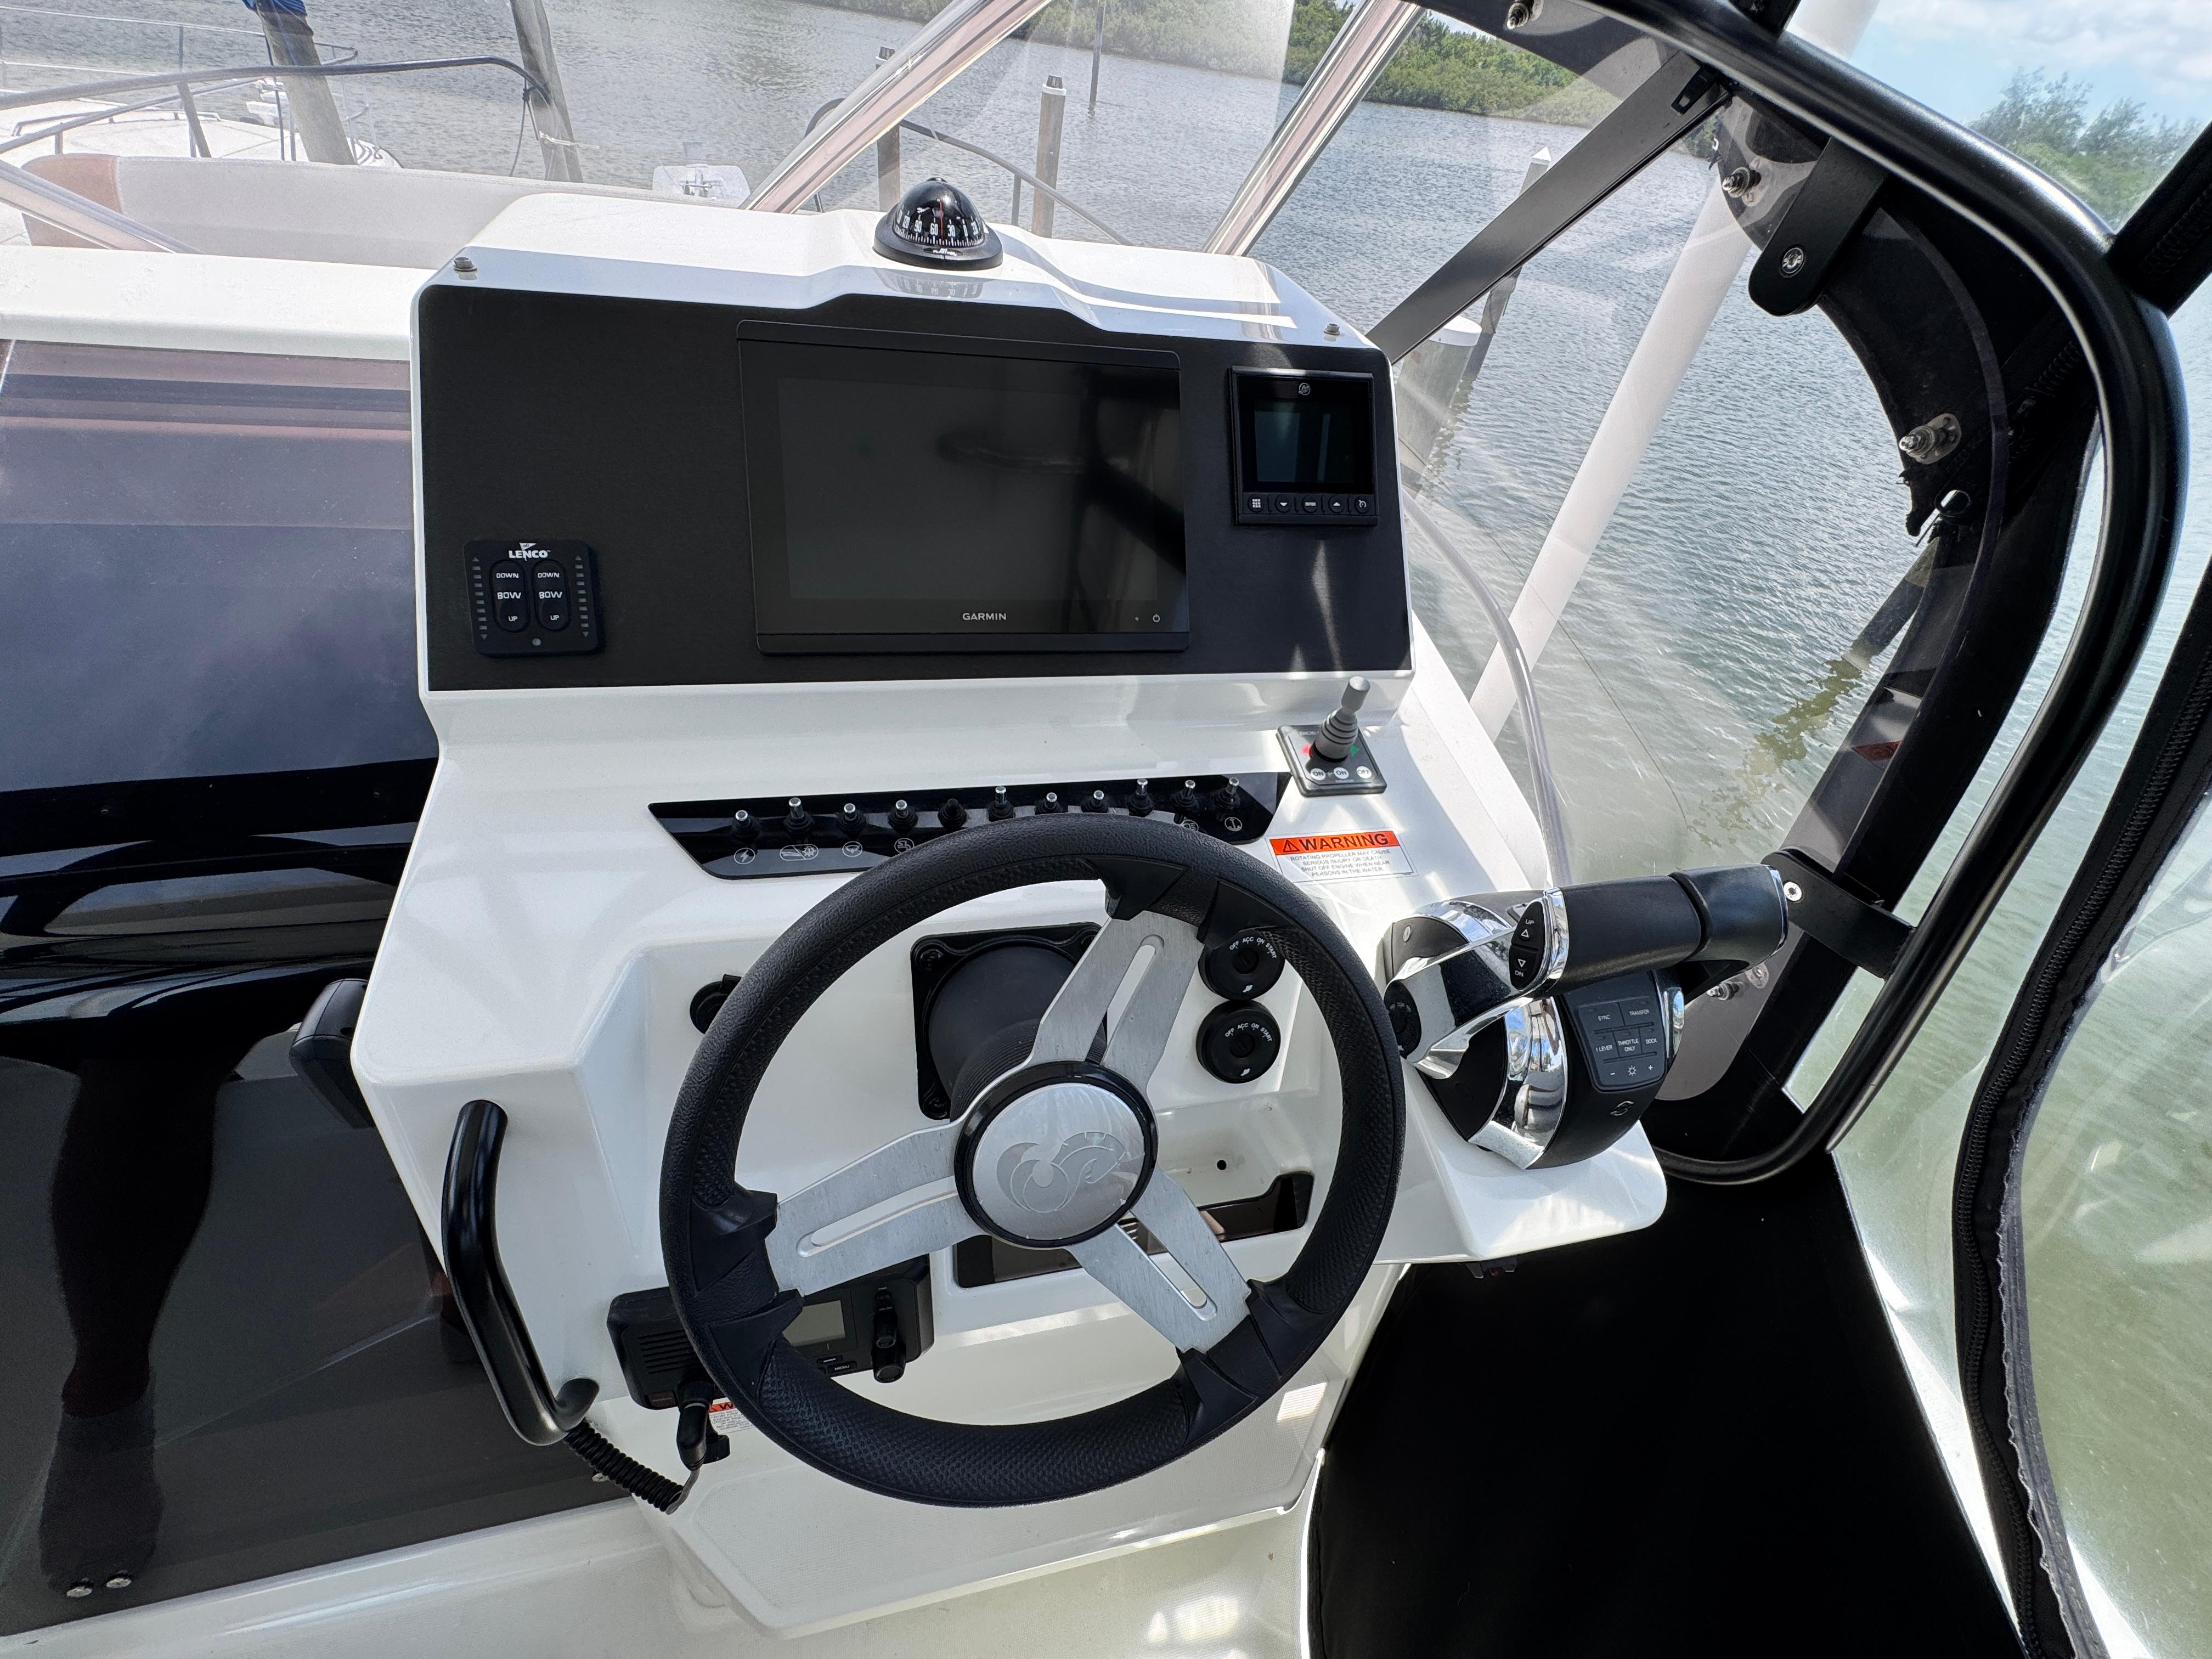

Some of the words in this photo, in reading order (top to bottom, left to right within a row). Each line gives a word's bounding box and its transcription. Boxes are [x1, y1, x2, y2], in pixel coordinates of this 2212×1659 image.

[914, 219, 922, 233] 90
[930, 223, 938, 235] 60
[947, 224, 956, 237] 30
[963, 224, 968, 237] 0
[509, 550, 549, 560] LENCO
[962, 612, 1007, 621] GARMIN
[1299, 833, 1389, 851] WARNING
[1229, 940, 1239, 950] OFF
[1265, 943, 1277, 958] START
[1260, 1027, 1272, 1041] START
